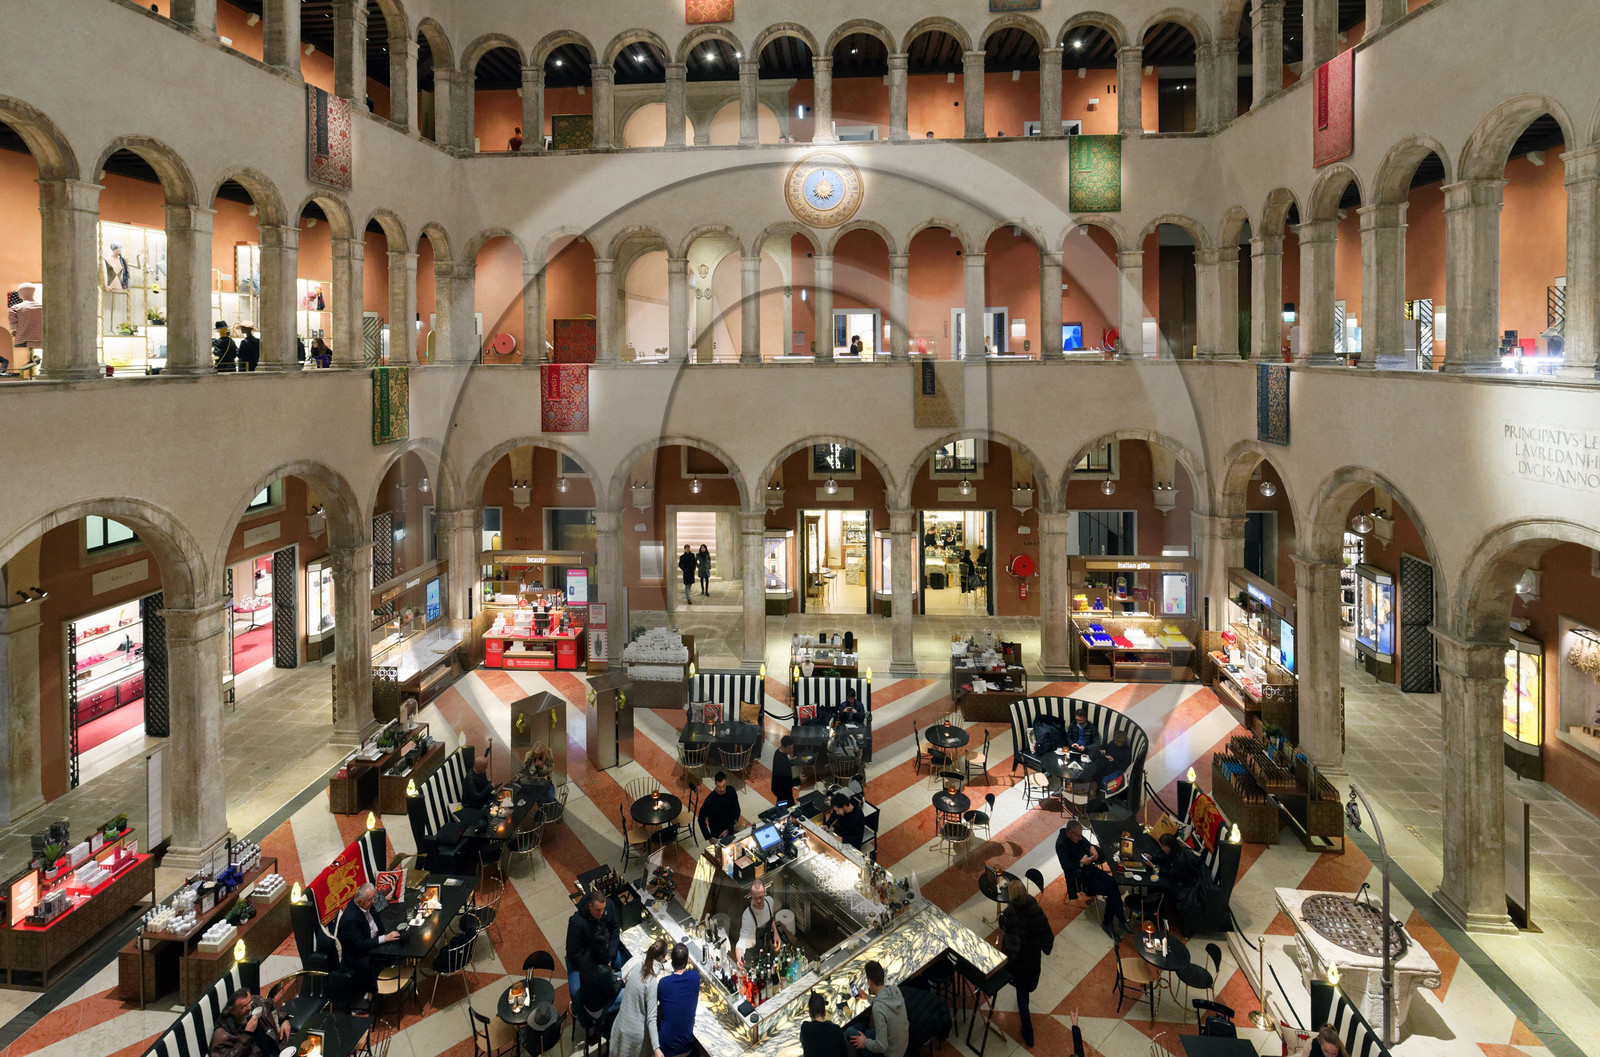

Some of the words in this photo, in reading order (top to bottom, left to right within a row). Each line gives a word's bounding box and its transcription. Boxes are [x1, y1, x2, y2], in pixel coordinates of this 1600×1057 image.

[925, 368, 933, 393] jewelry
[1555, 466, 1600, 488] ANNO
[526, 556, 546, 564] beauty
[1136, 562, 1151, 570] gifts
